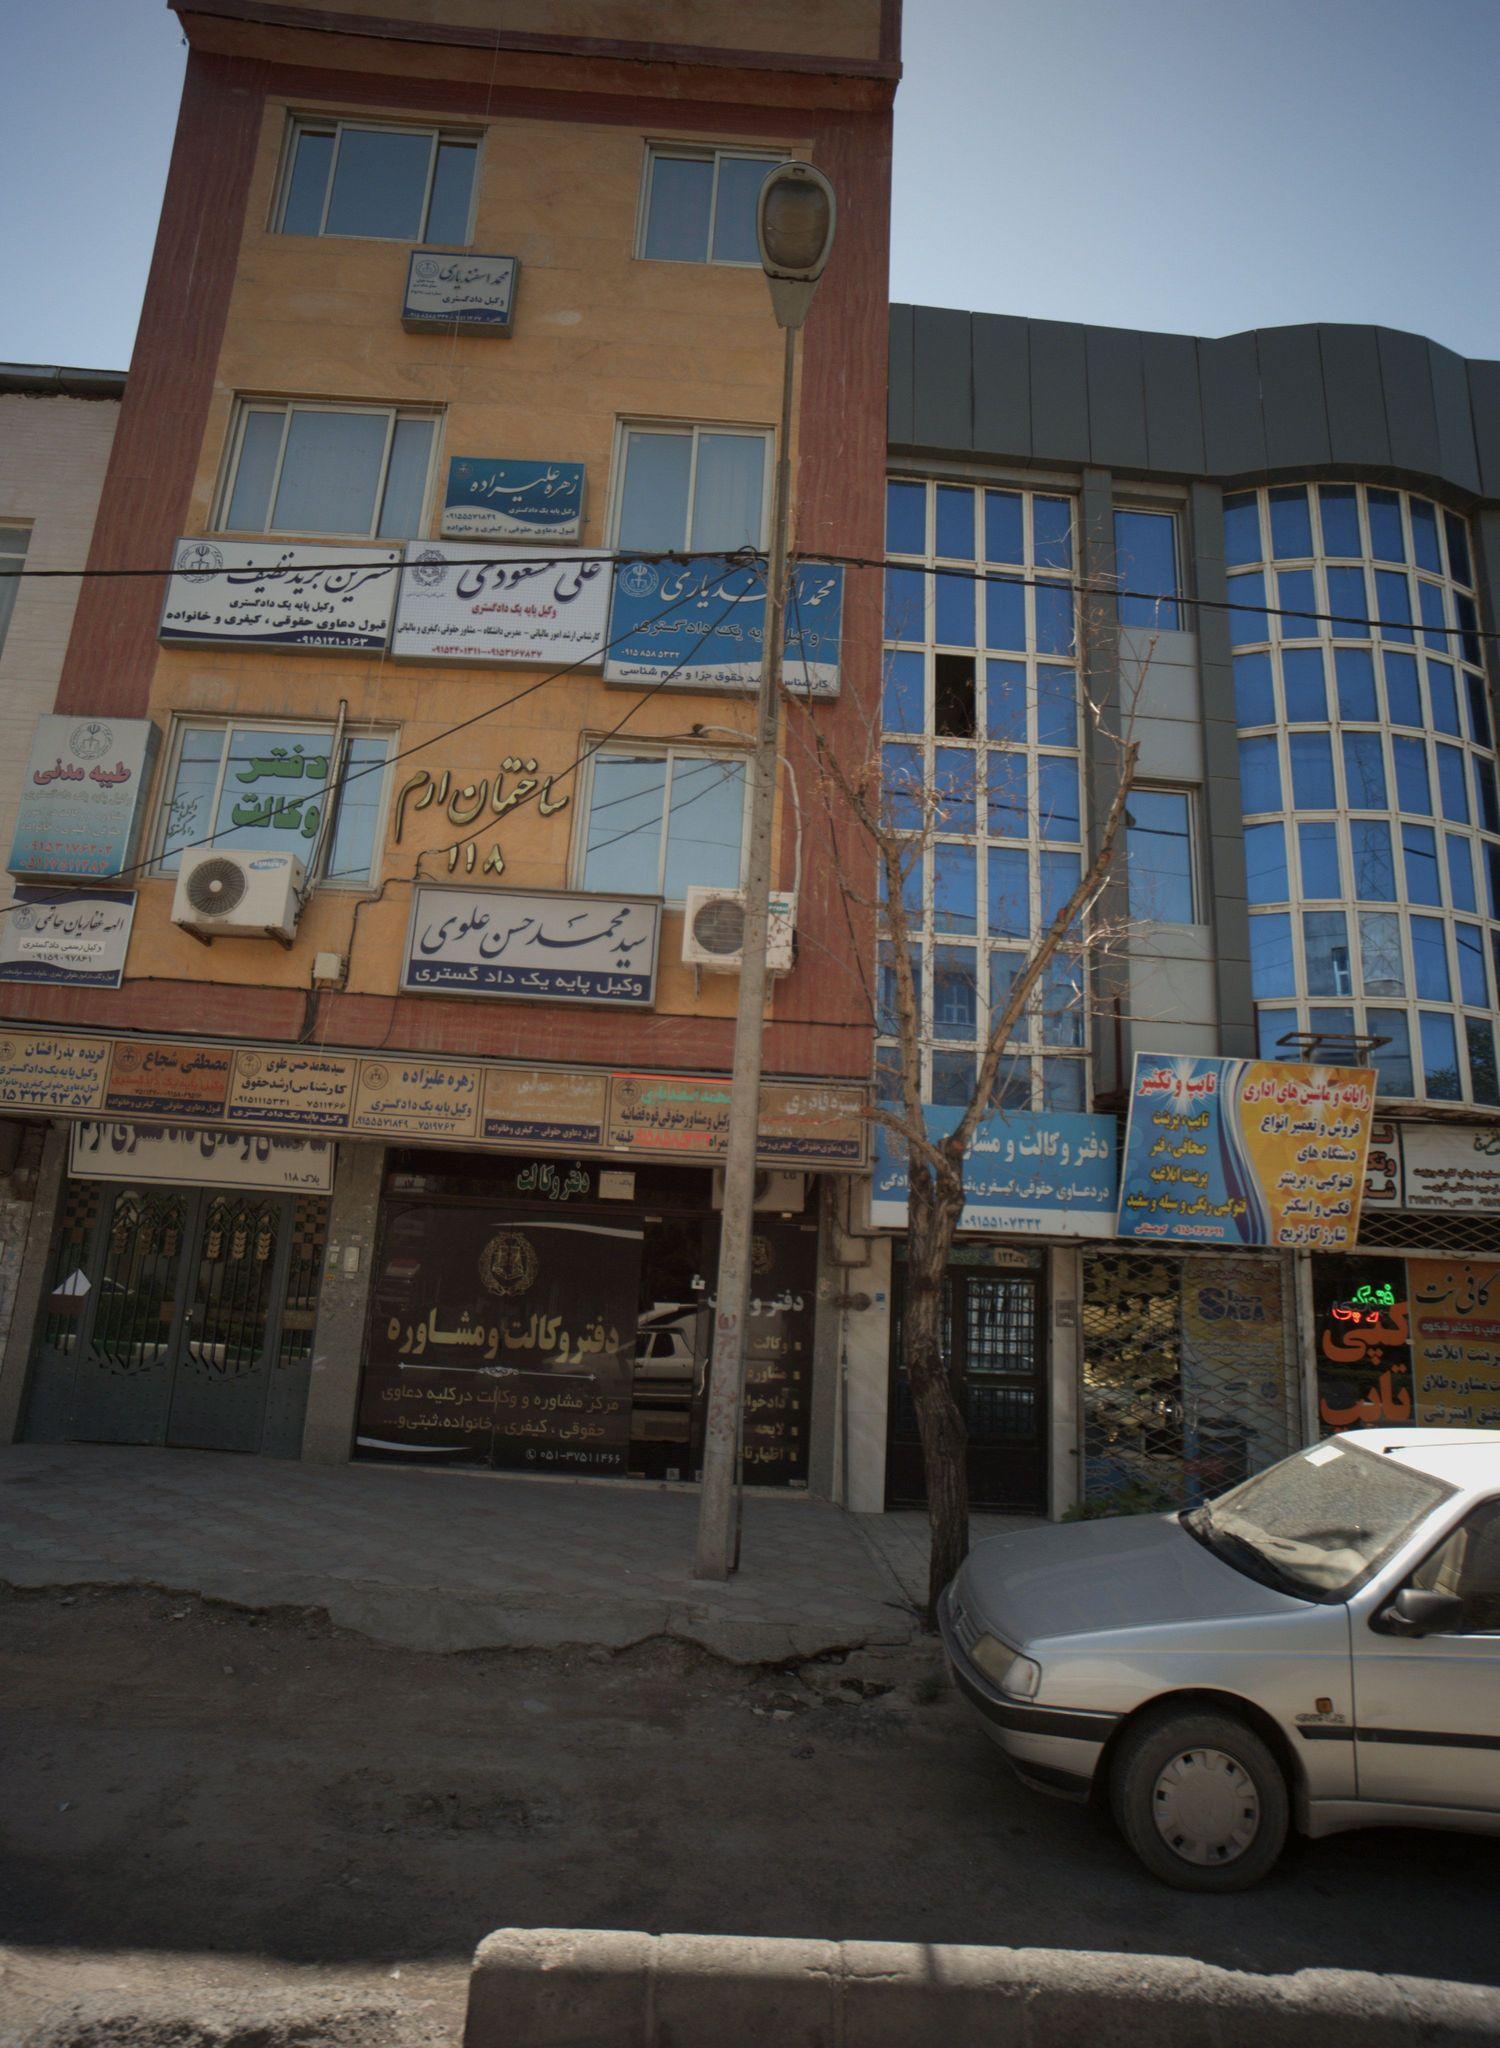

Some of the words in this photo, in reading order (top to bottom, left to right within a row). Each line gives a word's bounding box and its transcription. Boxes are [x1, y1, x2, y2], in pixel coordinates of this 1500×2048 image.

[484, 296, 505, 307] وکیل
[544, 474, 579, 499] زهره
[553, 557, 602, 604] علی
[229, 596, 276, 610] دادگستری
[802, 578, 837, 607] محمد
[166, 605, 211, 622] خانواده
[279, 598, 294, 610] یک
[295, 599, 312, 613] پایه
[314, 600, 335, 614] وکیل
[471, 600, 507, 615] دادگستری
[508, 601, 522, 614] یک
[522, 602, 537, 616] پایه
[538, 604, 558, 619] وکیل
[214, 613, 221, 625] و
[224, 611, 262, 626] کیفری
[271, 613, 314, 629] حقوقی
[316, 615, 356, 631] دعاوی
[358, 617, 388, 633] قبول
[89, 761, 132, 789] طیبه
[235, 744, 328, 784] دفتر
[447, 756, 571, 827] ساختمان
[231, 792, 321, 839] وکالت
[394, 770, 453, 845] ارم
[447, 842, 506, 875] ۱۱۸
[420, 904, 491, 955] علوی
[479, 917, 536, 959] حسن
[525, 907, 633, 949] محمد
[609, 934, 649, 968] سید
[520, 970, 550, 992] یک
[555, 973, 592, 996] پایه
[596, 977, 643, 997] وکیل
[76, 1068, 98, 1082] وکیل
[446, 1071, 476, 1093] زهره
[1137, 1068, 1173, 1096] تکثیر
[1186, 1072, 1218, 1100] تایپ
[1174, 1079, 1182, 1098] و
[1242, 1077, 1277, 1103] اداری
[1275, 1082, 1299, 1104] های
[1299, 1084, 1332, 1106] ماشین
[1332, 1091, 1341, 1108] و
[1341, 1084, 1371, 1111] رایانه
[320, 1113, 345, 1125] وکیل
[450, 1102, 473, 1118] وکیل
[1152, 1110, 1181, 1131] پرینت
[1186, 1110, 1210, 1131] تایپ
[1260, 1112, 1289, 1135] انواع
[1289, 1116, 1318, 1136] تعمیر
[1317, 1121, 1326, 1137] و
[1326, 1117, 1361, 1139] فروش
[1005, 1140, 1017, 1163] و
[1018, 1131, 1071, 1167] وکالت
[1075, 1132, 1110, 1168] دفتر
[1171, 1136, 1208, 1159] صحافی
[1296, 1144, 1319, 1165] های
[1319, 1146, 1358, 1163] دستگاه
[1150, 1164, 1181, 1185] ابلاغیه
[1180, 1168, 1210, 1189] پرینت
[1277, 1172, 1308, 1191] پرینتر
[1314, 1173, 1354, 1193] فتوکپی
[1186, 1193, 1213, 1216] رنگی
[1211, 1195, 1247, 1218] فتوکپی
[1281, 1199, 1313, 1216] اسکنر
[1321, 1202, 1351, 1219] فکس
[1278, 1223, 1320, 1245] کارتریج
[765, 1289, 805, 1317] دفتر
[387, 1307, 486, 1354] مشاوره
[503, 1313, 571, 1363] وکالت
[570, 1315, 622, 1363] دفتر
[1322, 1300, 1408, 1365] کپی
[483, 1326, 500, 1358] و
[381, 1385, 424, 1403] دعاوی
[476, 1385, 518, 1408] وکالت
[520, 1395, 530, 1409] و
[533, 1392, 583, 1411] مشاوره
[584, 1394, 620, 1414] مرکز
[559, 1416, 606, 1441] حقوقی
